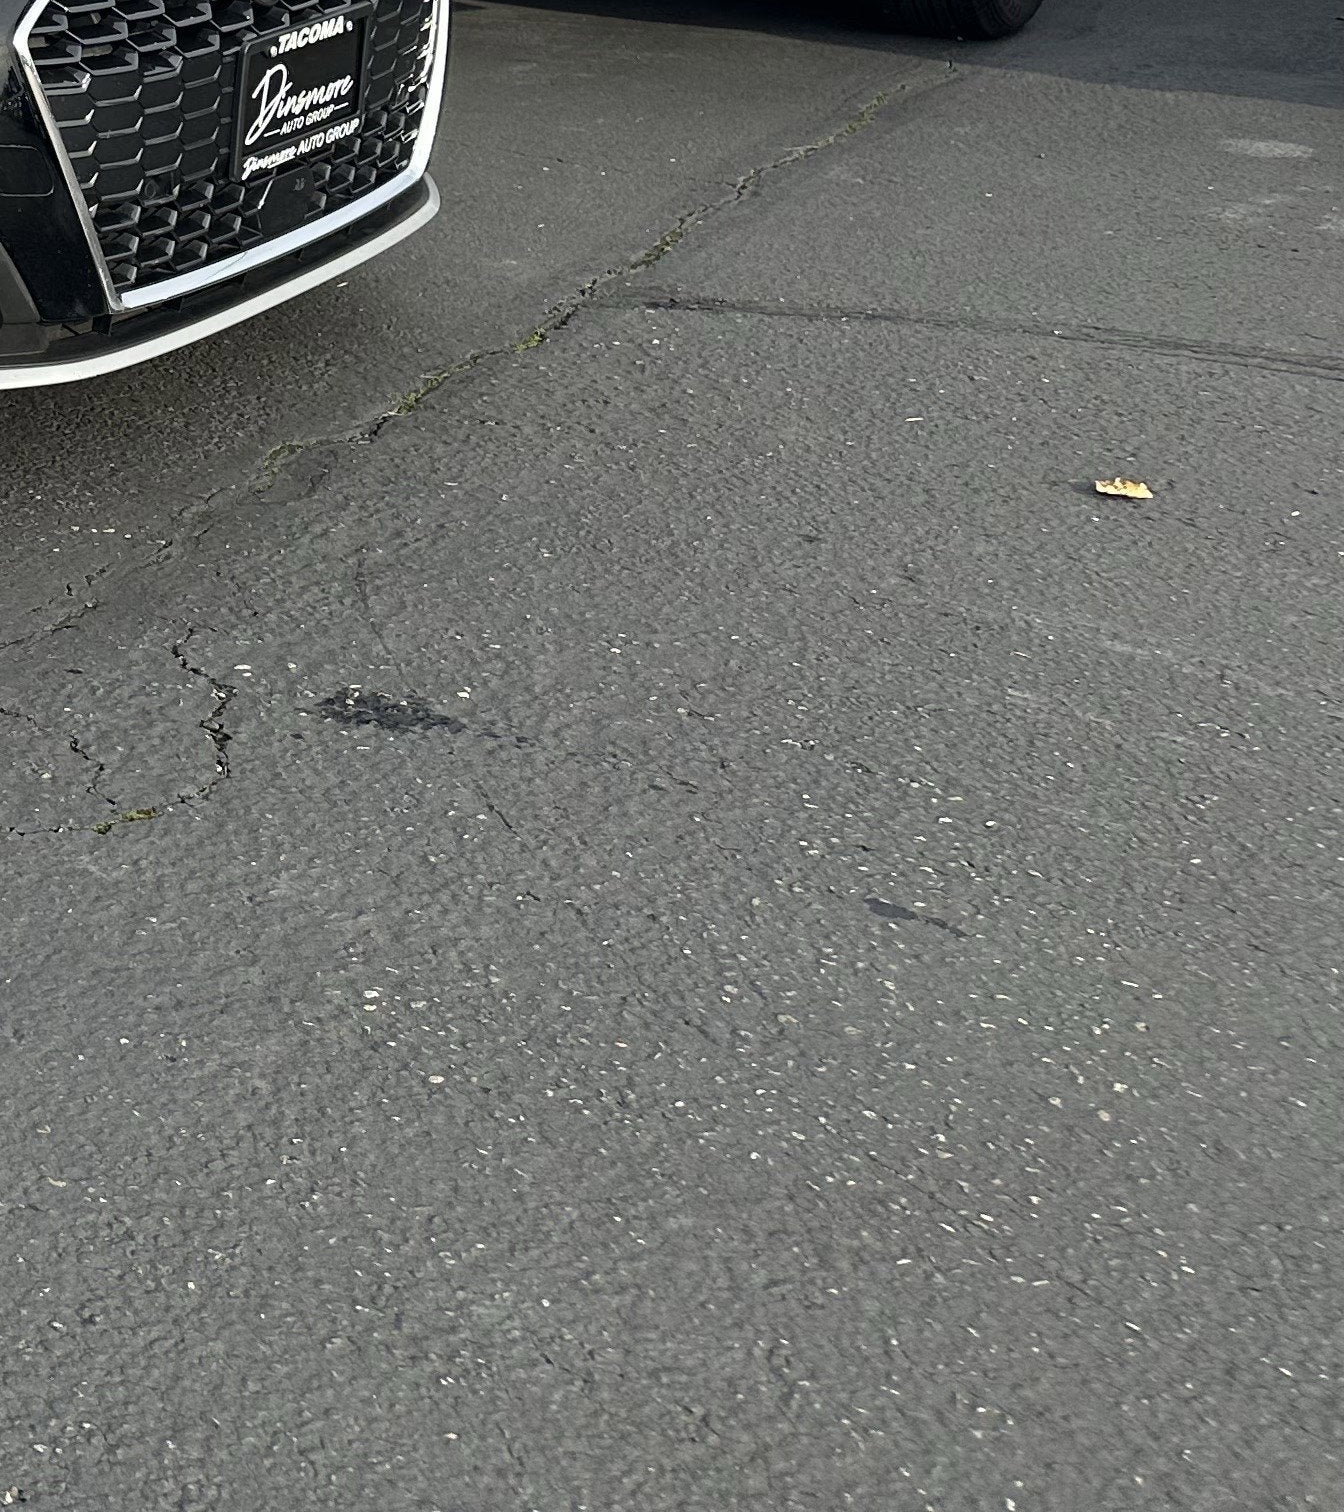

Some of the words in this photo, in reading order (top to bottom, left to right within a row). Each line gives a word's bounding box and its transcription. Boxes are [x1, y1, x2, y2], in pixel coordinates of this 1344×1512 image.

[277, 16, 345, 55] TACOMA
[244, 64, 355, 145] Dinsmore
[280, 116, 304, 136] AUTO
[305, 104, 335, 128] GROUP
[242, 145, 297, 180] Dinsmore
[297, 135, 324, 155] AUTO
[325, 118, 360, 143] GROUP
